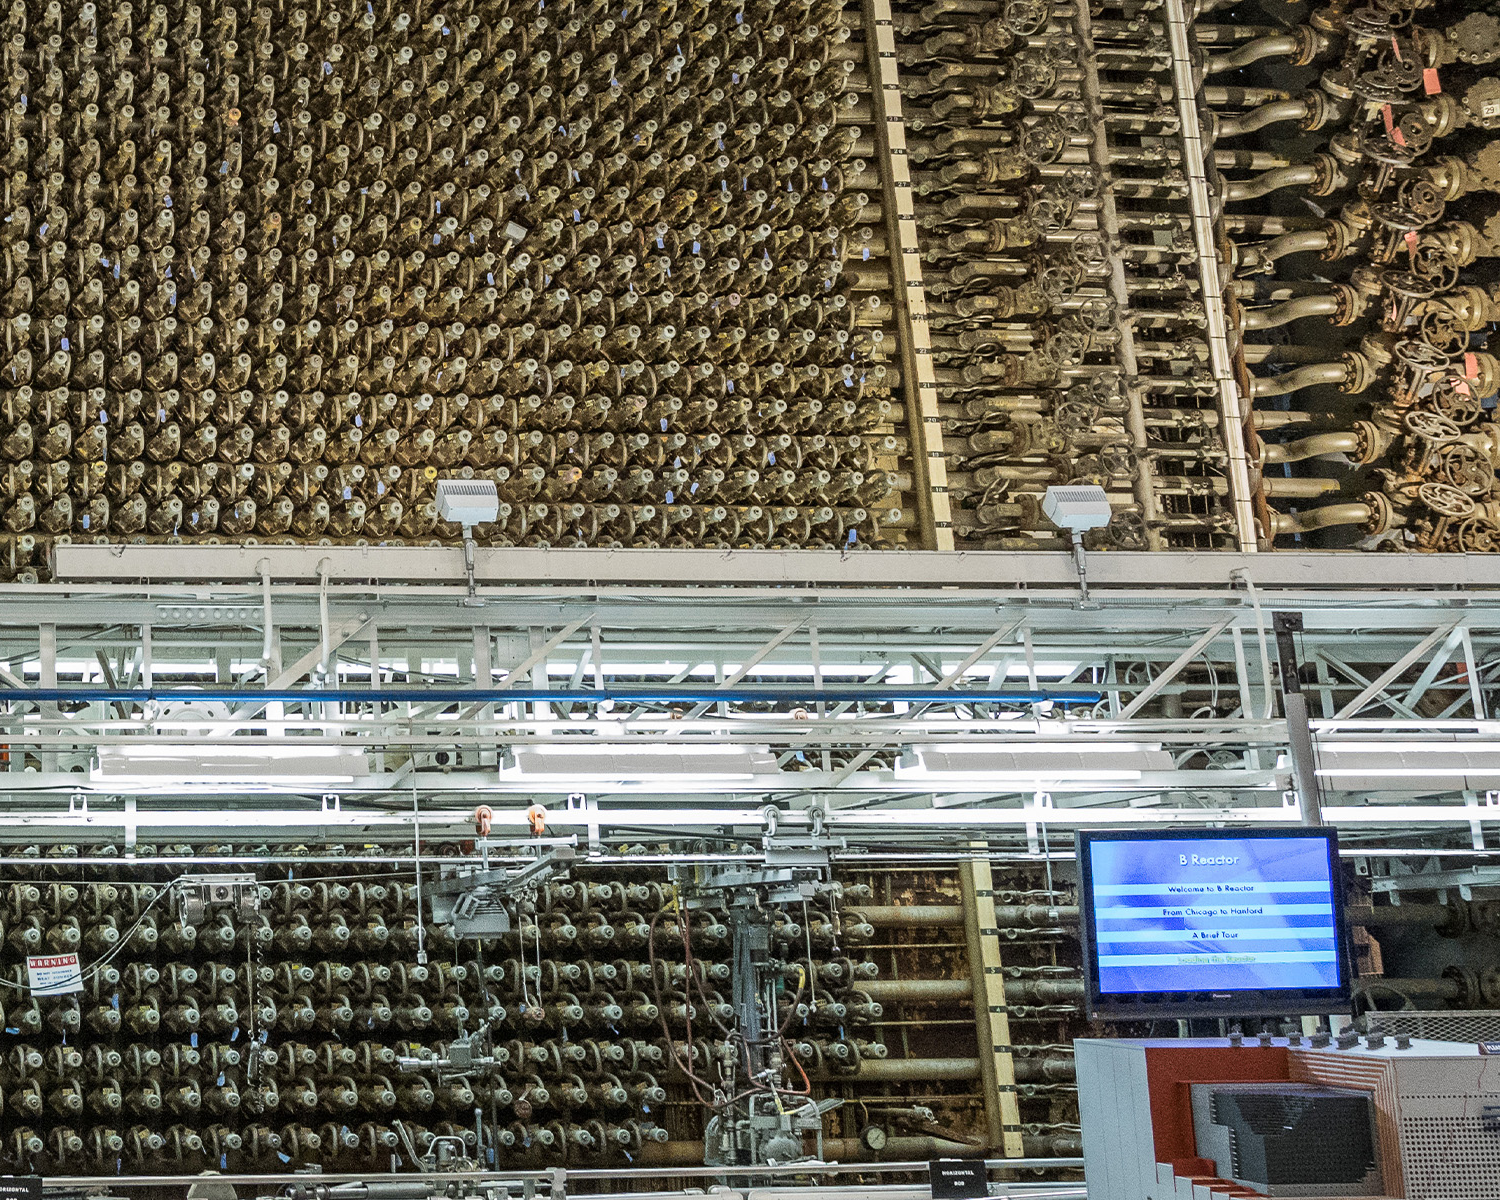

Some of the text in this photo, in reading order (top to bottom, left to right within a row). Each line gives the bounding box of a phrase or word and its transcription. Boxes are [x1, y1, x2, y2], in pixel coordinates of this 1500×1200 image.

[1485, 106, 1495, 115] 29
[1179, 854, 1239, 866] B Reactor
[1167, 885, 1204, 893] Welcome
[1224, 884, 1254, 892] Reactor
[1162, 908, 1183, 916] From
[1185, 907, 1218, 917] Chicago
[1230, 907, 1263, 915] Hanford
[1201, 931, 1219, 939] Brief
[1222, 931, 1238, 939] Tour
[30, 956, 75, 967] WARNING
